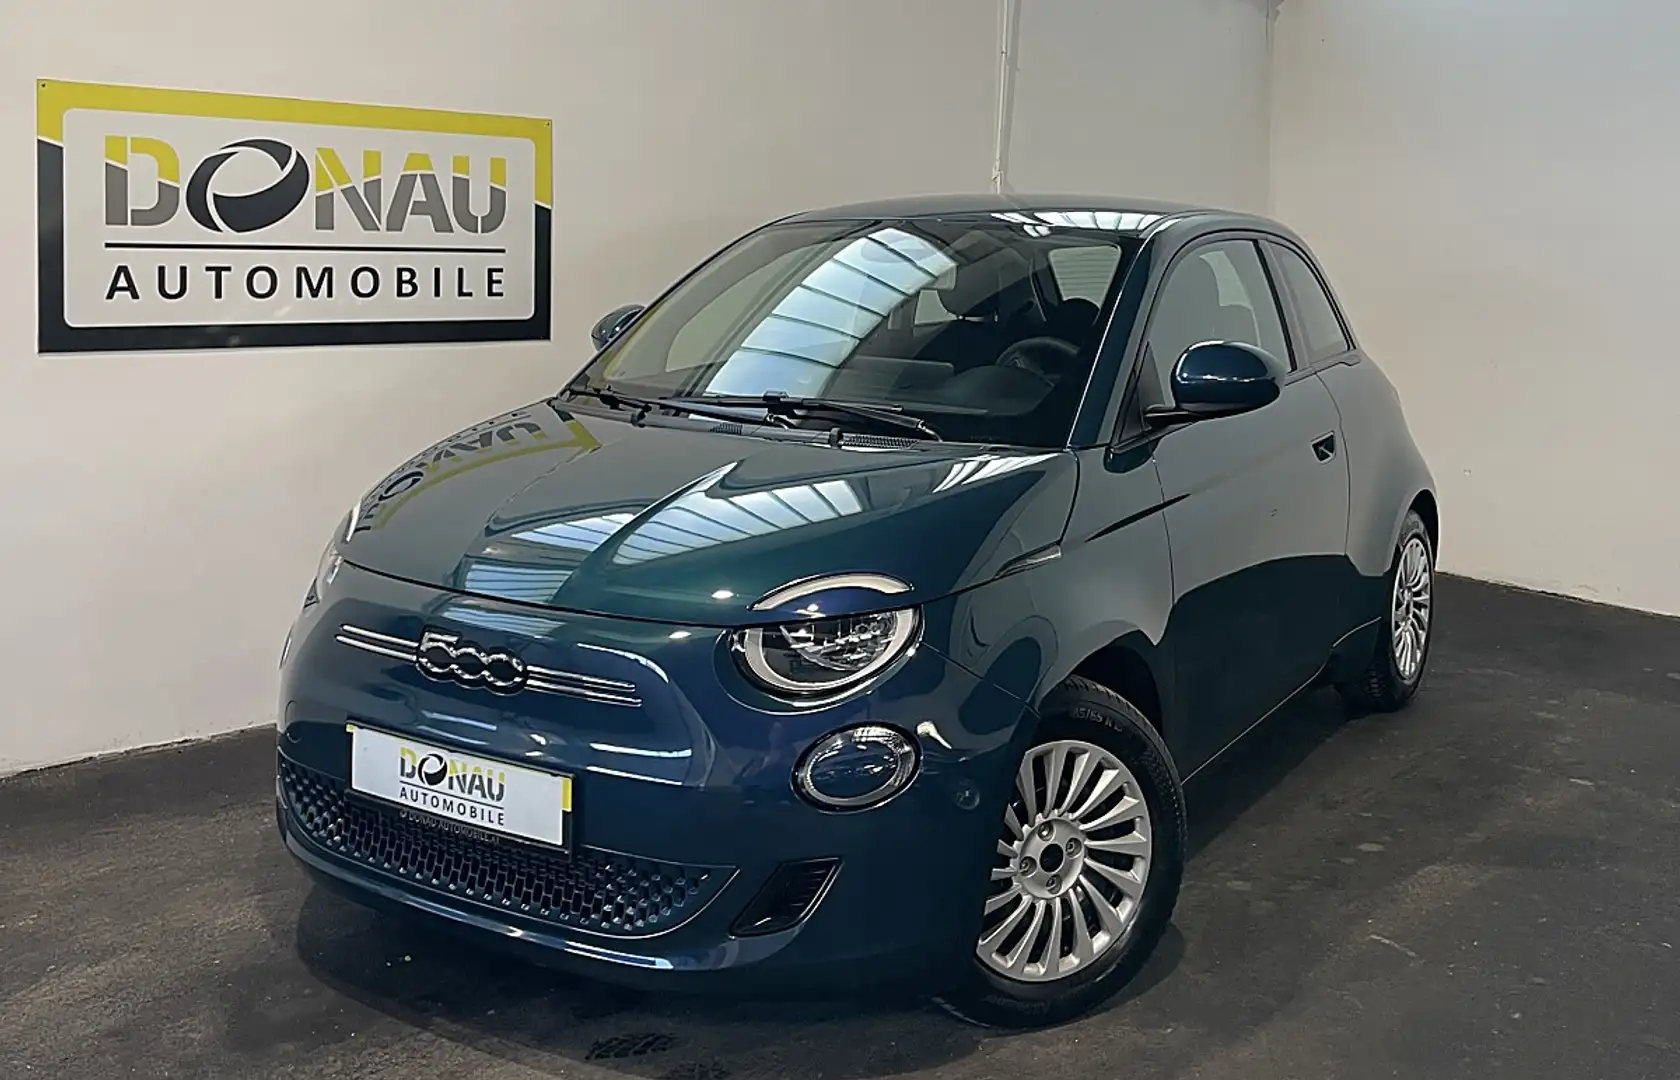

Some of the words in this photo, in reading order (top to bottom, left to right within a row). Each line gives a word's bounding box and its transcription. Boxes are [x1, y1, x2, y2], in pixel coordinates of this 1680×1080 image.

[105, 136, 507, 233] DONAU
[105, 265, 506, 300] AUTOMOBILE
[417, 629, 525, 690] 500
[400, 747, 506, 801] DONAU
[399, 786, 505, 826] AUTOMOBILE
